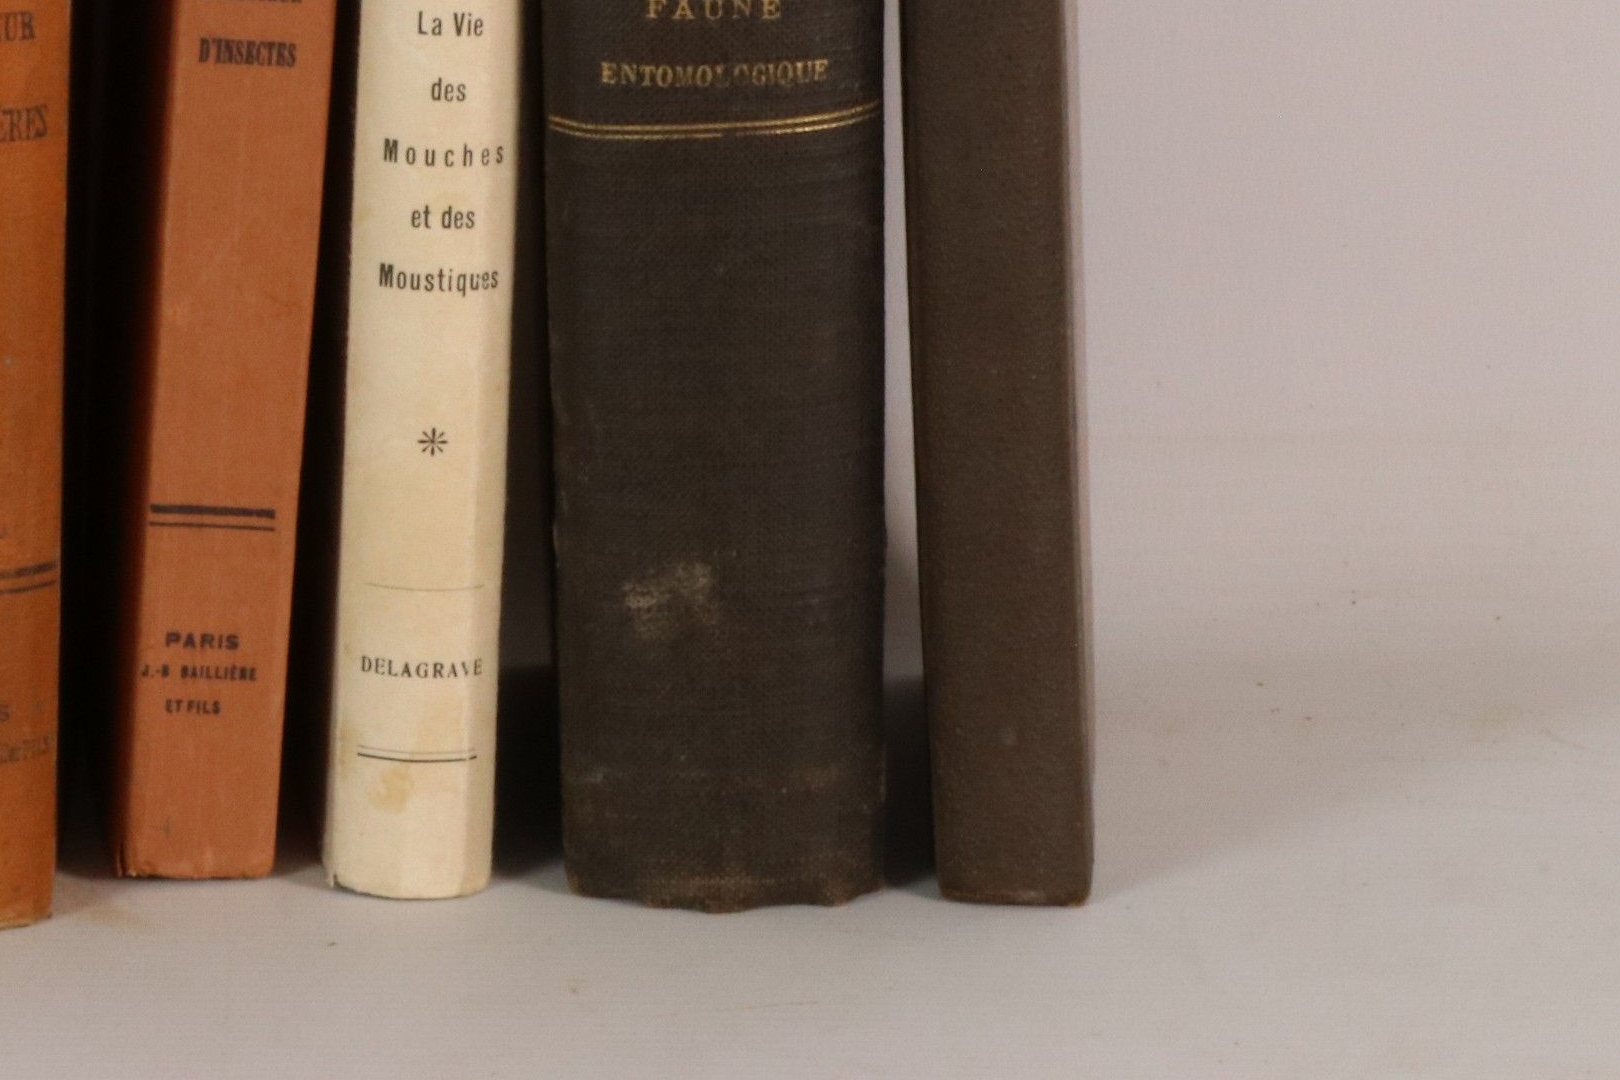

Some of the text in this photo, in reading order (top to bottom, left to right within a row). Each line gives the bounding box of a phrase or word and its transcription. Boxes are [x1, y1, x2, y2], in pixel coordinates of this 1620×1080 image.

[417, 10, 484, 37] La Vie
[198, 37, 297, 69] D'INSECTES
[431, 77, 467, 102] des
[383, 138, 504, 167] Mouches
[411, 205, 475, 230] et des
[379, 263, 499, 297] Moustiques
[165, 631, 239, 651] PARIS
[361, 655, 483, 679] DELAGRAVE
[165, 698, 221, 715] ET FILS
